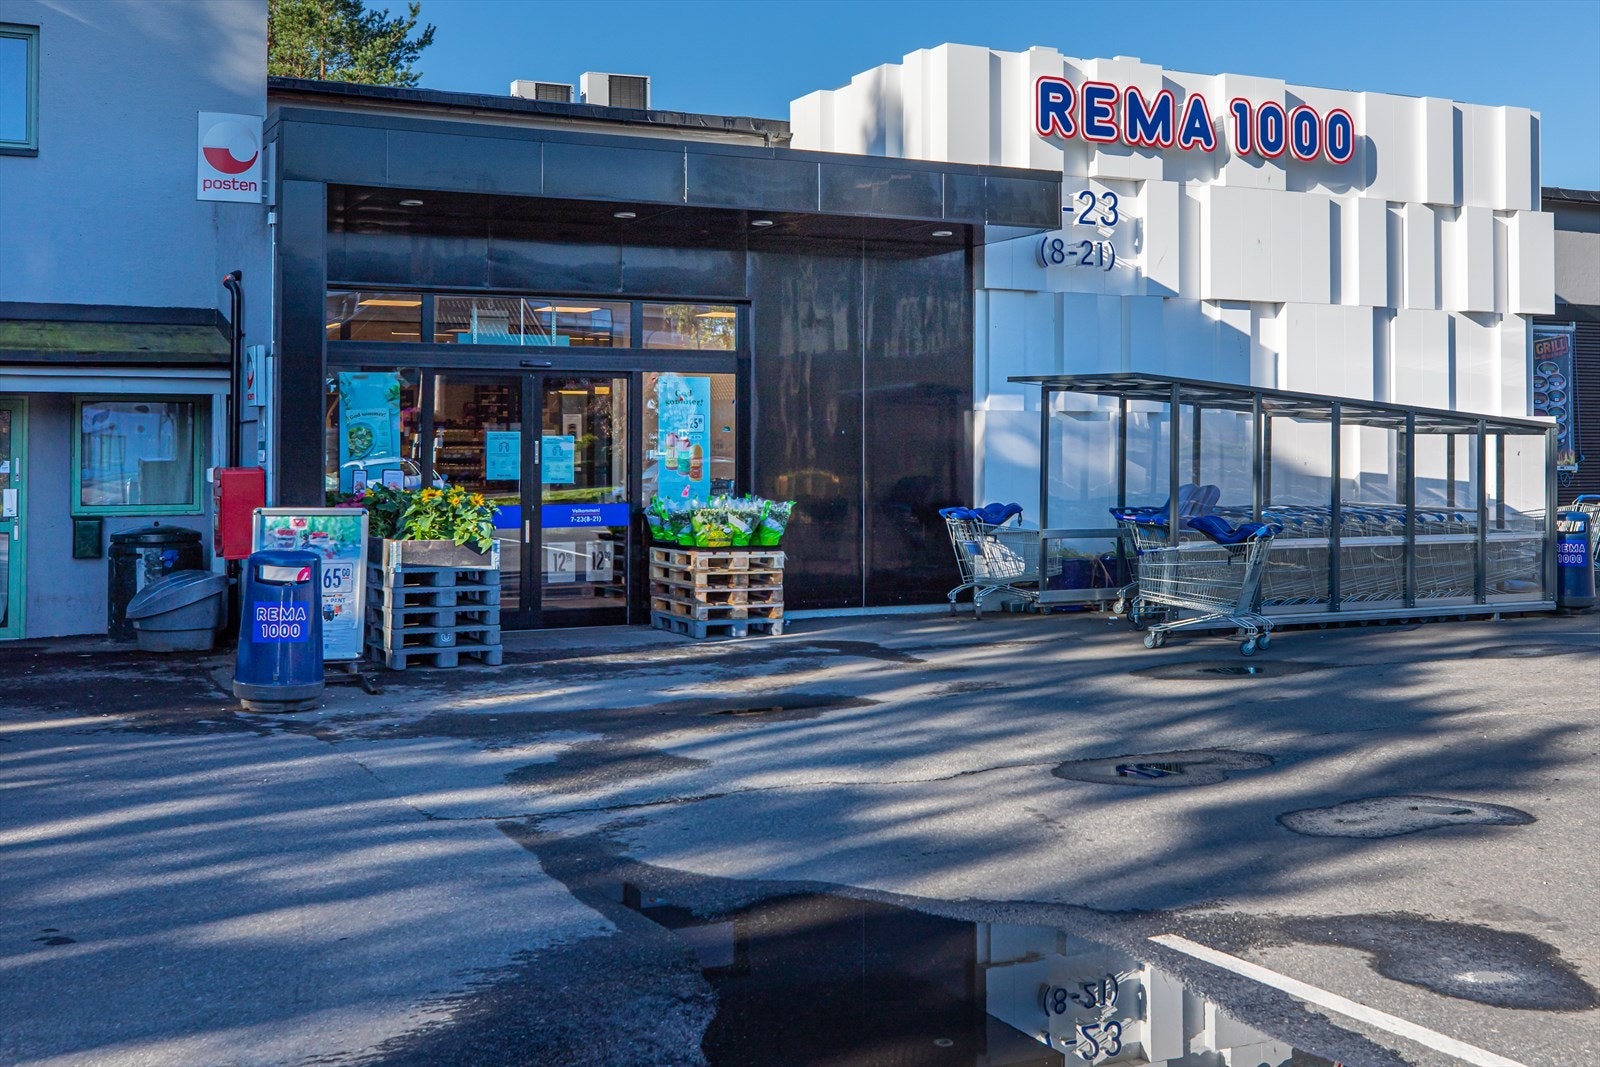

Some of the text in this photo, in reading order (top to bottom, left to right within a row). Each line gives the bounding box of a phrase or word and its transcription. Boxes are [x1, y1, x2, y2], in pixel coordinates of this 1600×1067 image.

[1035, 75, 1355, 165] REMA 1000
[203, 177, 257, 192] posten
[1040, 236, 1116, 271] (8-21)
[1535, 338, 1566, 355] GRILL
[553, 552, 566, 572] 12
[592, 551, 604, 570] 12
[1557, 553, 1583, 564] 1000
[323, 568, 341, 588] 65
[256, 607, 306, 622] REMA
[261, 624, 300, 638] 1000
